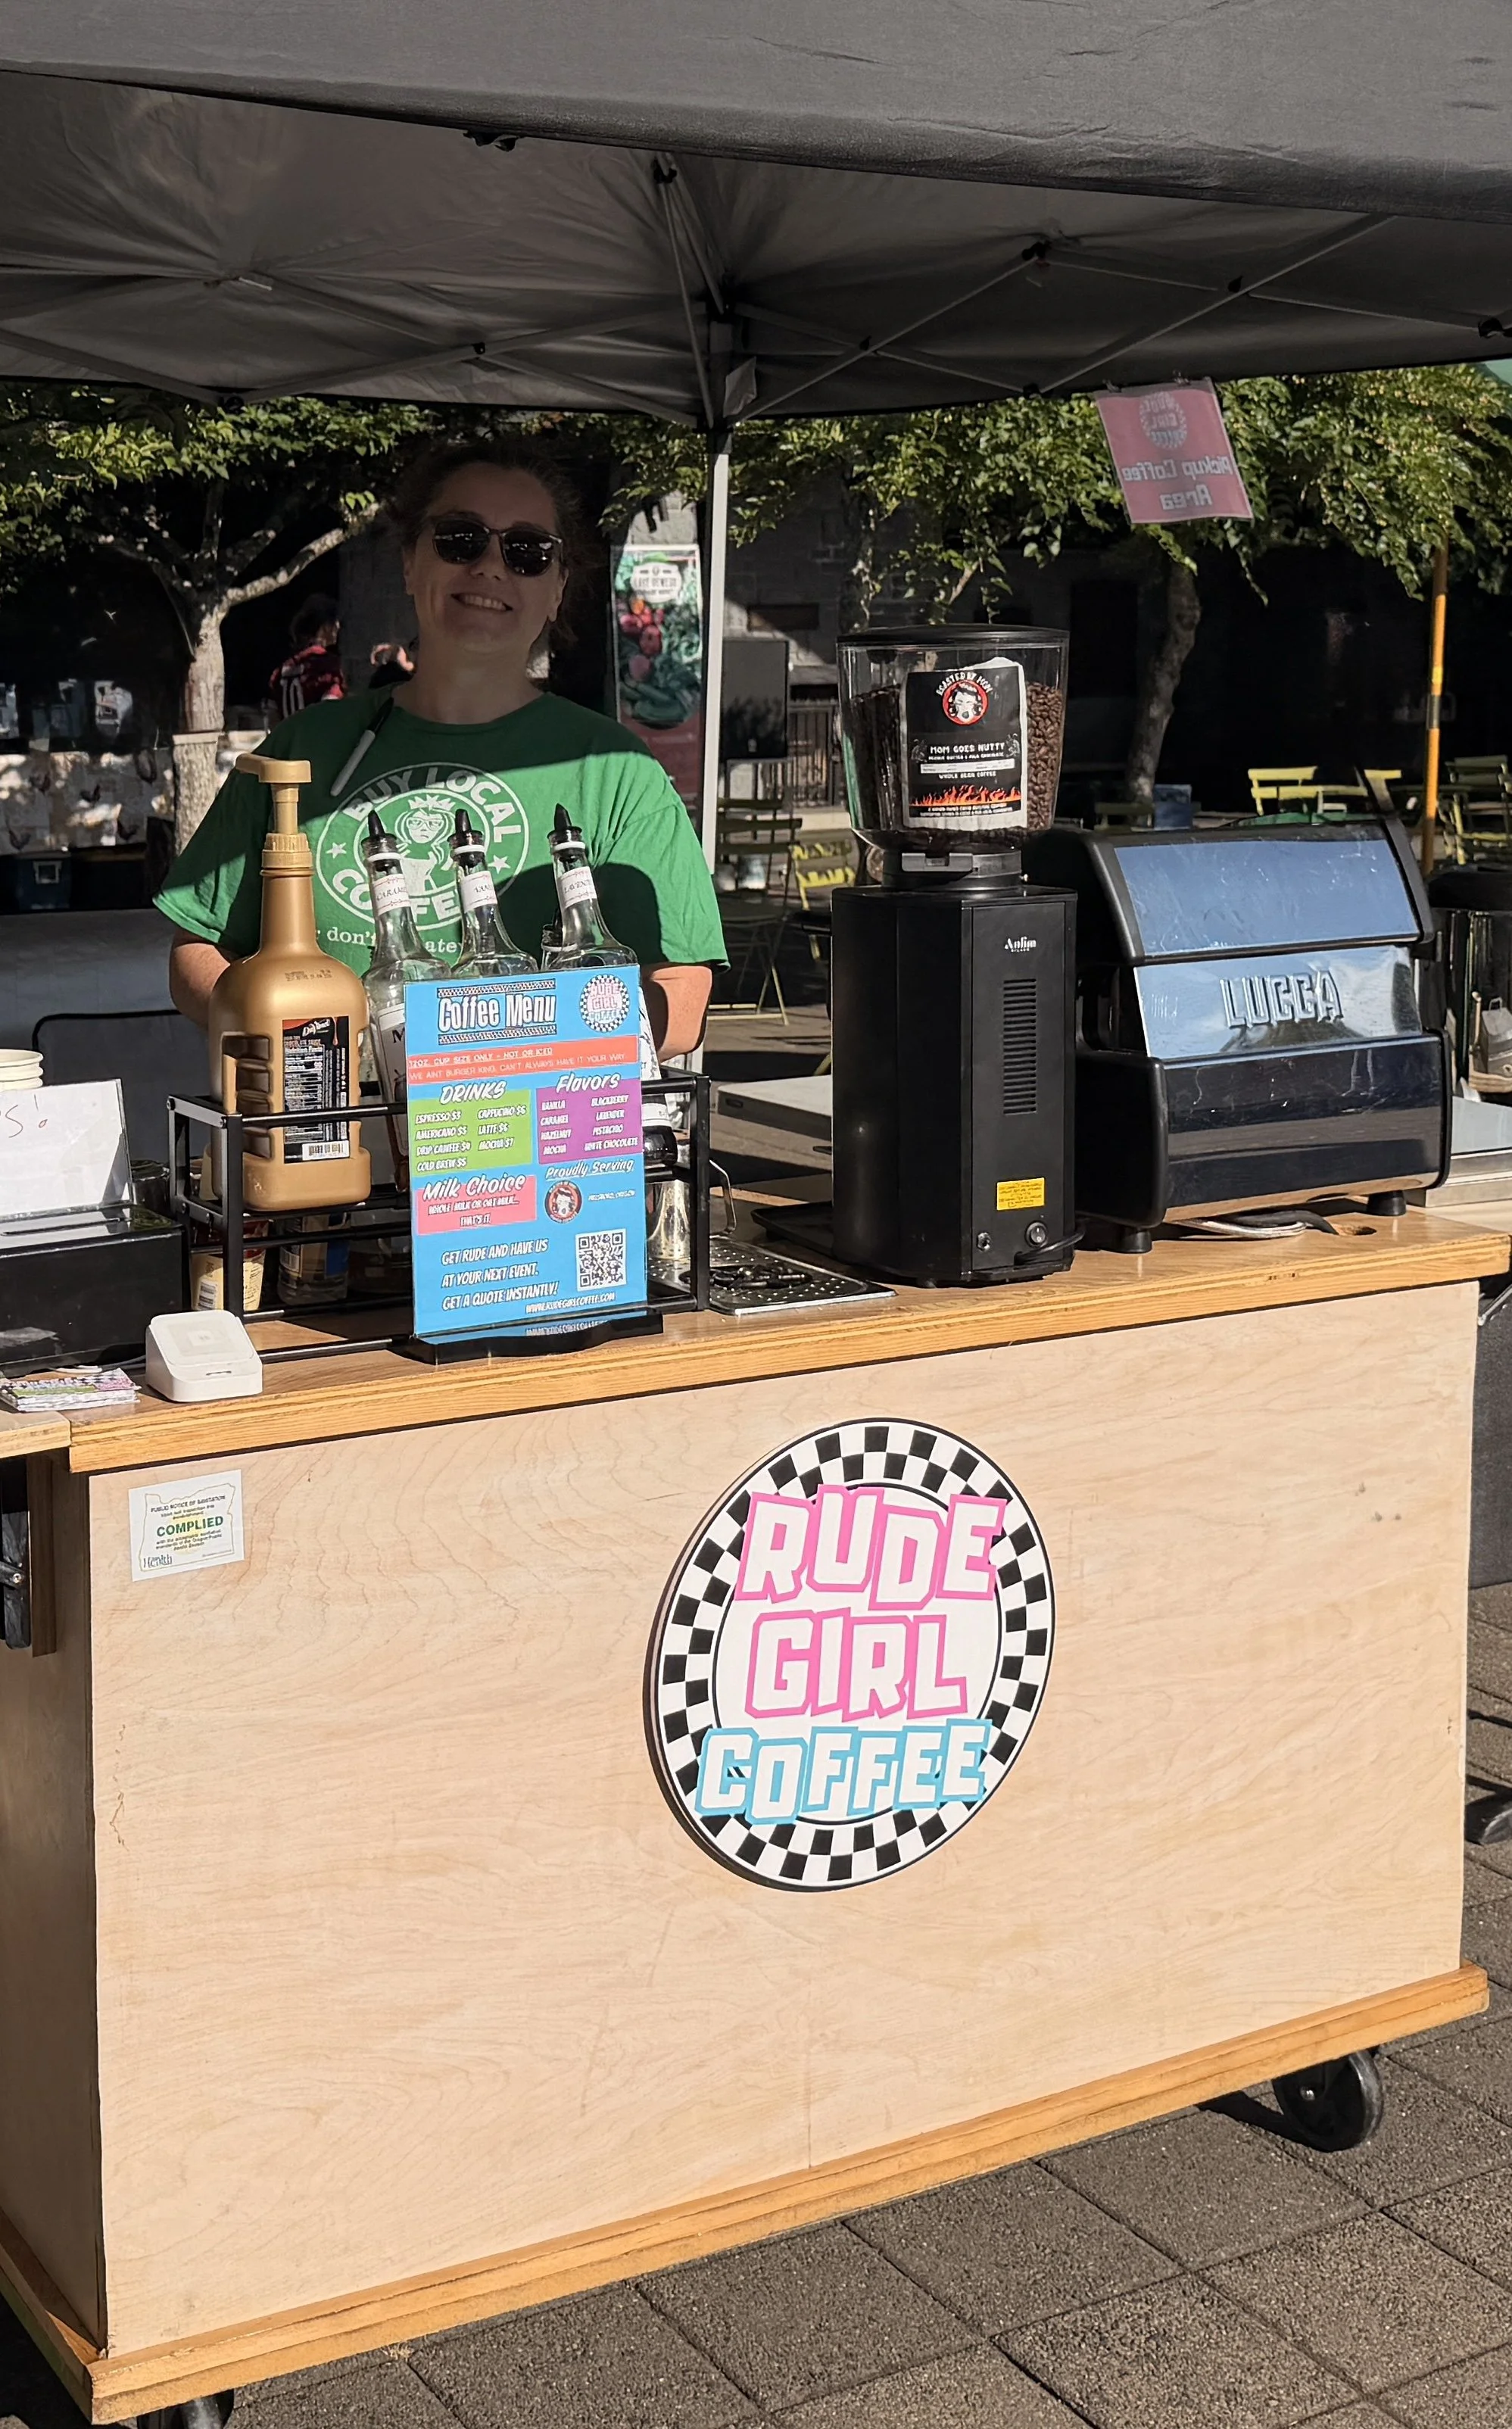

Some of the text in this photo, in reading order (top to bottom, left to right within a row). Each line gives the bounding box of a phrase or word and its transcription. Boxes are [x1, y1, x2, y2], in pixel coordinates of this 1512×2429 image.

[930, 742, 1005, 754] MOM GOES NUTTY
[342, 767, 522, 843] BUY LOCAL
[592, 995, 618, 1009] GIRL
[1220, 970, 1344, 1028] LUCCA
[438, 993, 556, 1032] Coffee Menu
[445, 1068, 475, 1077] BURGER
[525, 1059, 554, 1069] ALWAYS
[556, 1057, 575, 1065] HAVE
[588, 1054, 606, 1062] YOUR
[454, 1055, 471, 1064] SIZE
[474, 1053, 493, 1062] ONLY
[503, 1050, 519, 1059] HOT
[535, 1047, 553, 1055] ICED
[556, 1071, 621, 1093] Flavors
[439, 1080, 507, 1105] DRINKS
[591, 1094, 629, 1107] BLACKBERRY
[415, 1112, 451, 1125] ESPRESSO
[540, 1115, 569, 1126] CARAMEL
[415, 1126, 457, 1141] AMERICANO
[478, 1124, 497, 1136] LATTE
[504, 1137, 515, 1149] $7
[603, 1137, 638, 1149] CHOCOLATE
[417, 1160, 435, 1172] COLD
[545, 1161, 588, 1180] Proudly
[422, 1176, 462, 1202] Milk
[466, 1172, 527, 1197] Choice
[428, 1204, 451, 1216] WHOLE
[453, 1201, 471, 1212] MILK
[471, 1200, 482, 1209] OR
[460, 1214, 483, 1227] THAT'S
[441, 1237, 550, 1266] GET RUDE AND HAVE US
[441, 1261, 539, 1288] AT YOUR NEXT EVENT.
[442, 1280, 560, 1311] GET A QUOTE INSTANTLY!
[156, 1516, 224, 1537] COMPLIED
[735, 1484, 1008, 1610] RUDE
[745, 1607, 968, 1722] GIRL
[694, 1719, 993, 1825] COFFEE
